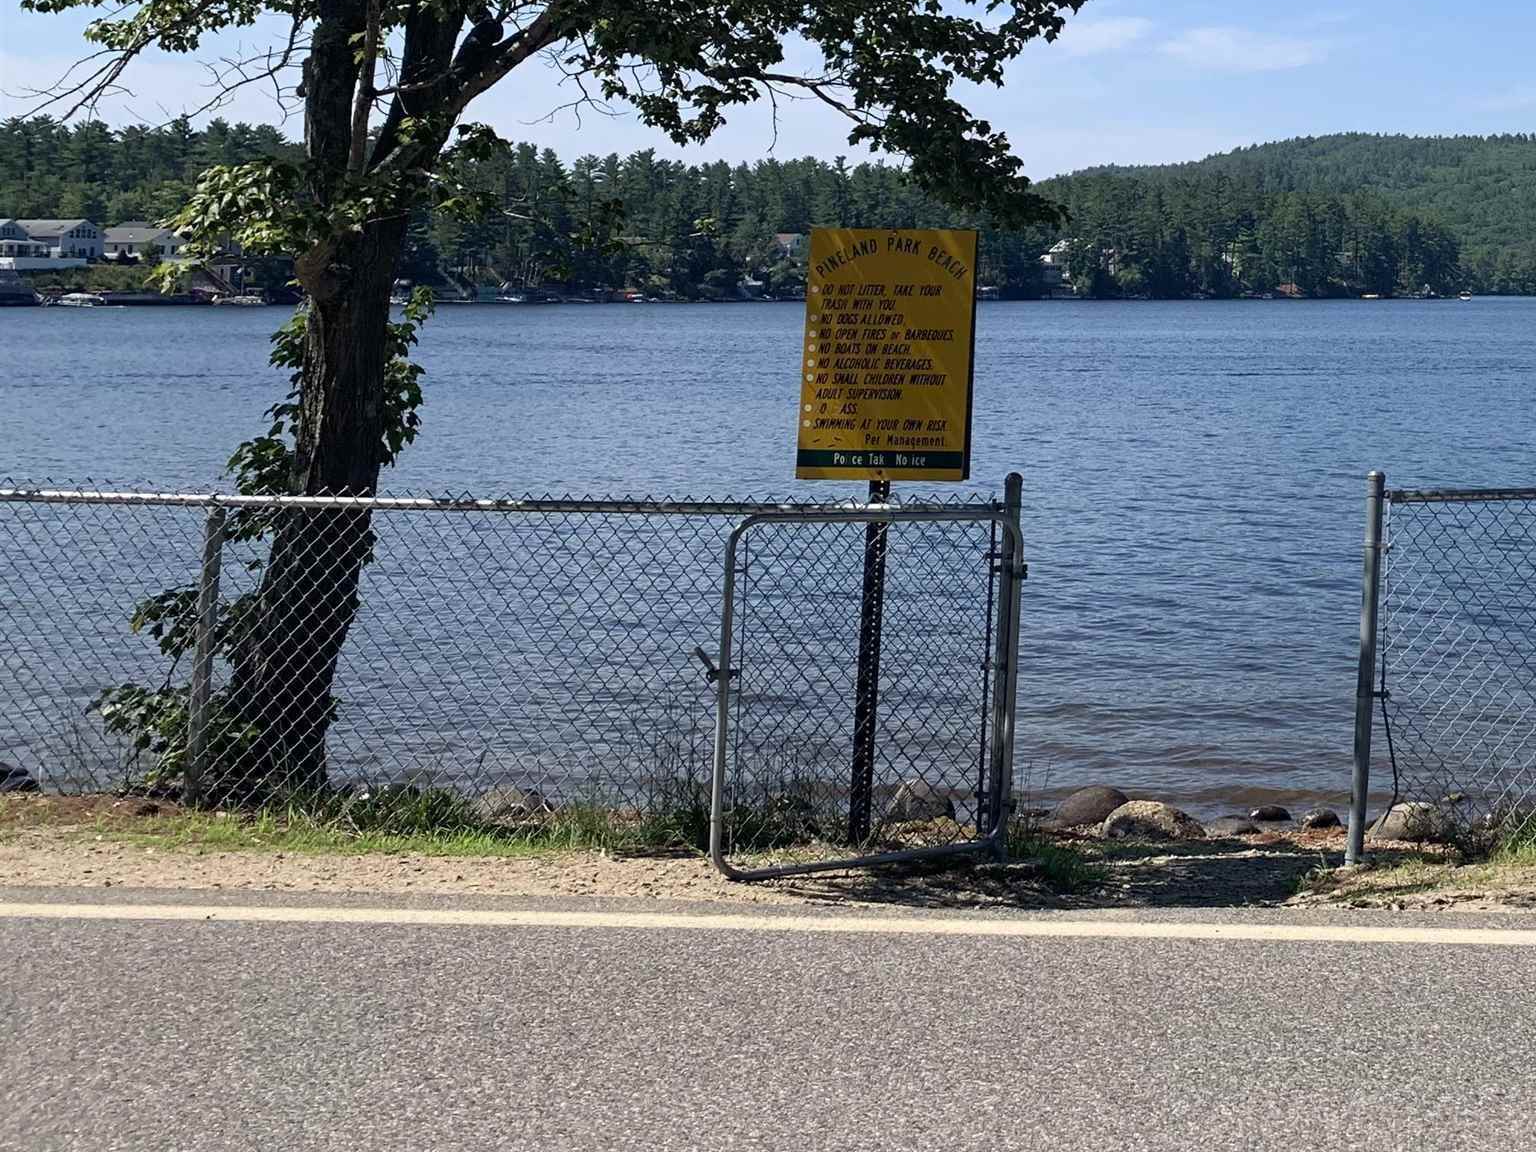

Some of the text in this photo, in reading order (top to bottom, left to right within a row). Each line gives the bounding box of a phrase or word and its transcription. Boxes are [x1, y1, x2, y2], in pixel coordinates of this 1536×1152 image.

[815, 237, 968, 280] PINELAND PARK BEACH
[822, 284, 833, 296] DO
[838, 285, 854, 296] NOT
[894, 285, 913, 296] TAKE
[919, 285, 942, 296] YOUR
[821, 299, 847, 310] TRASH
[852, 299, 872, 310] WITH
[820, 314, 832, 324] NO
[837, 314, 858, 325] DOGS
[819, 329, 831, 339] NO
[834, 329, 858, 340] OPEN
[862, 329, 886, 340] FIRES
[818, 343, 831, 354] NO
[834, 343, 860, 354] BOATS
[865, 344, 876, 354] ON
[818, 358, 829, 369] NO
[834, 358, 878, 369] ALCOHOLIC
[816, 374, 947, 386] NO SMALL CHILDREN WITHOUT
[816, 388, 841, 399] ADULT
[813, 418, 855, 429] SWIMMING
[859, 418, 872, 430] AT
[877, 419, 898, 430] YOUR
[902, 419, 920, 430] OWN
[865, 434, 881, 445] Per
